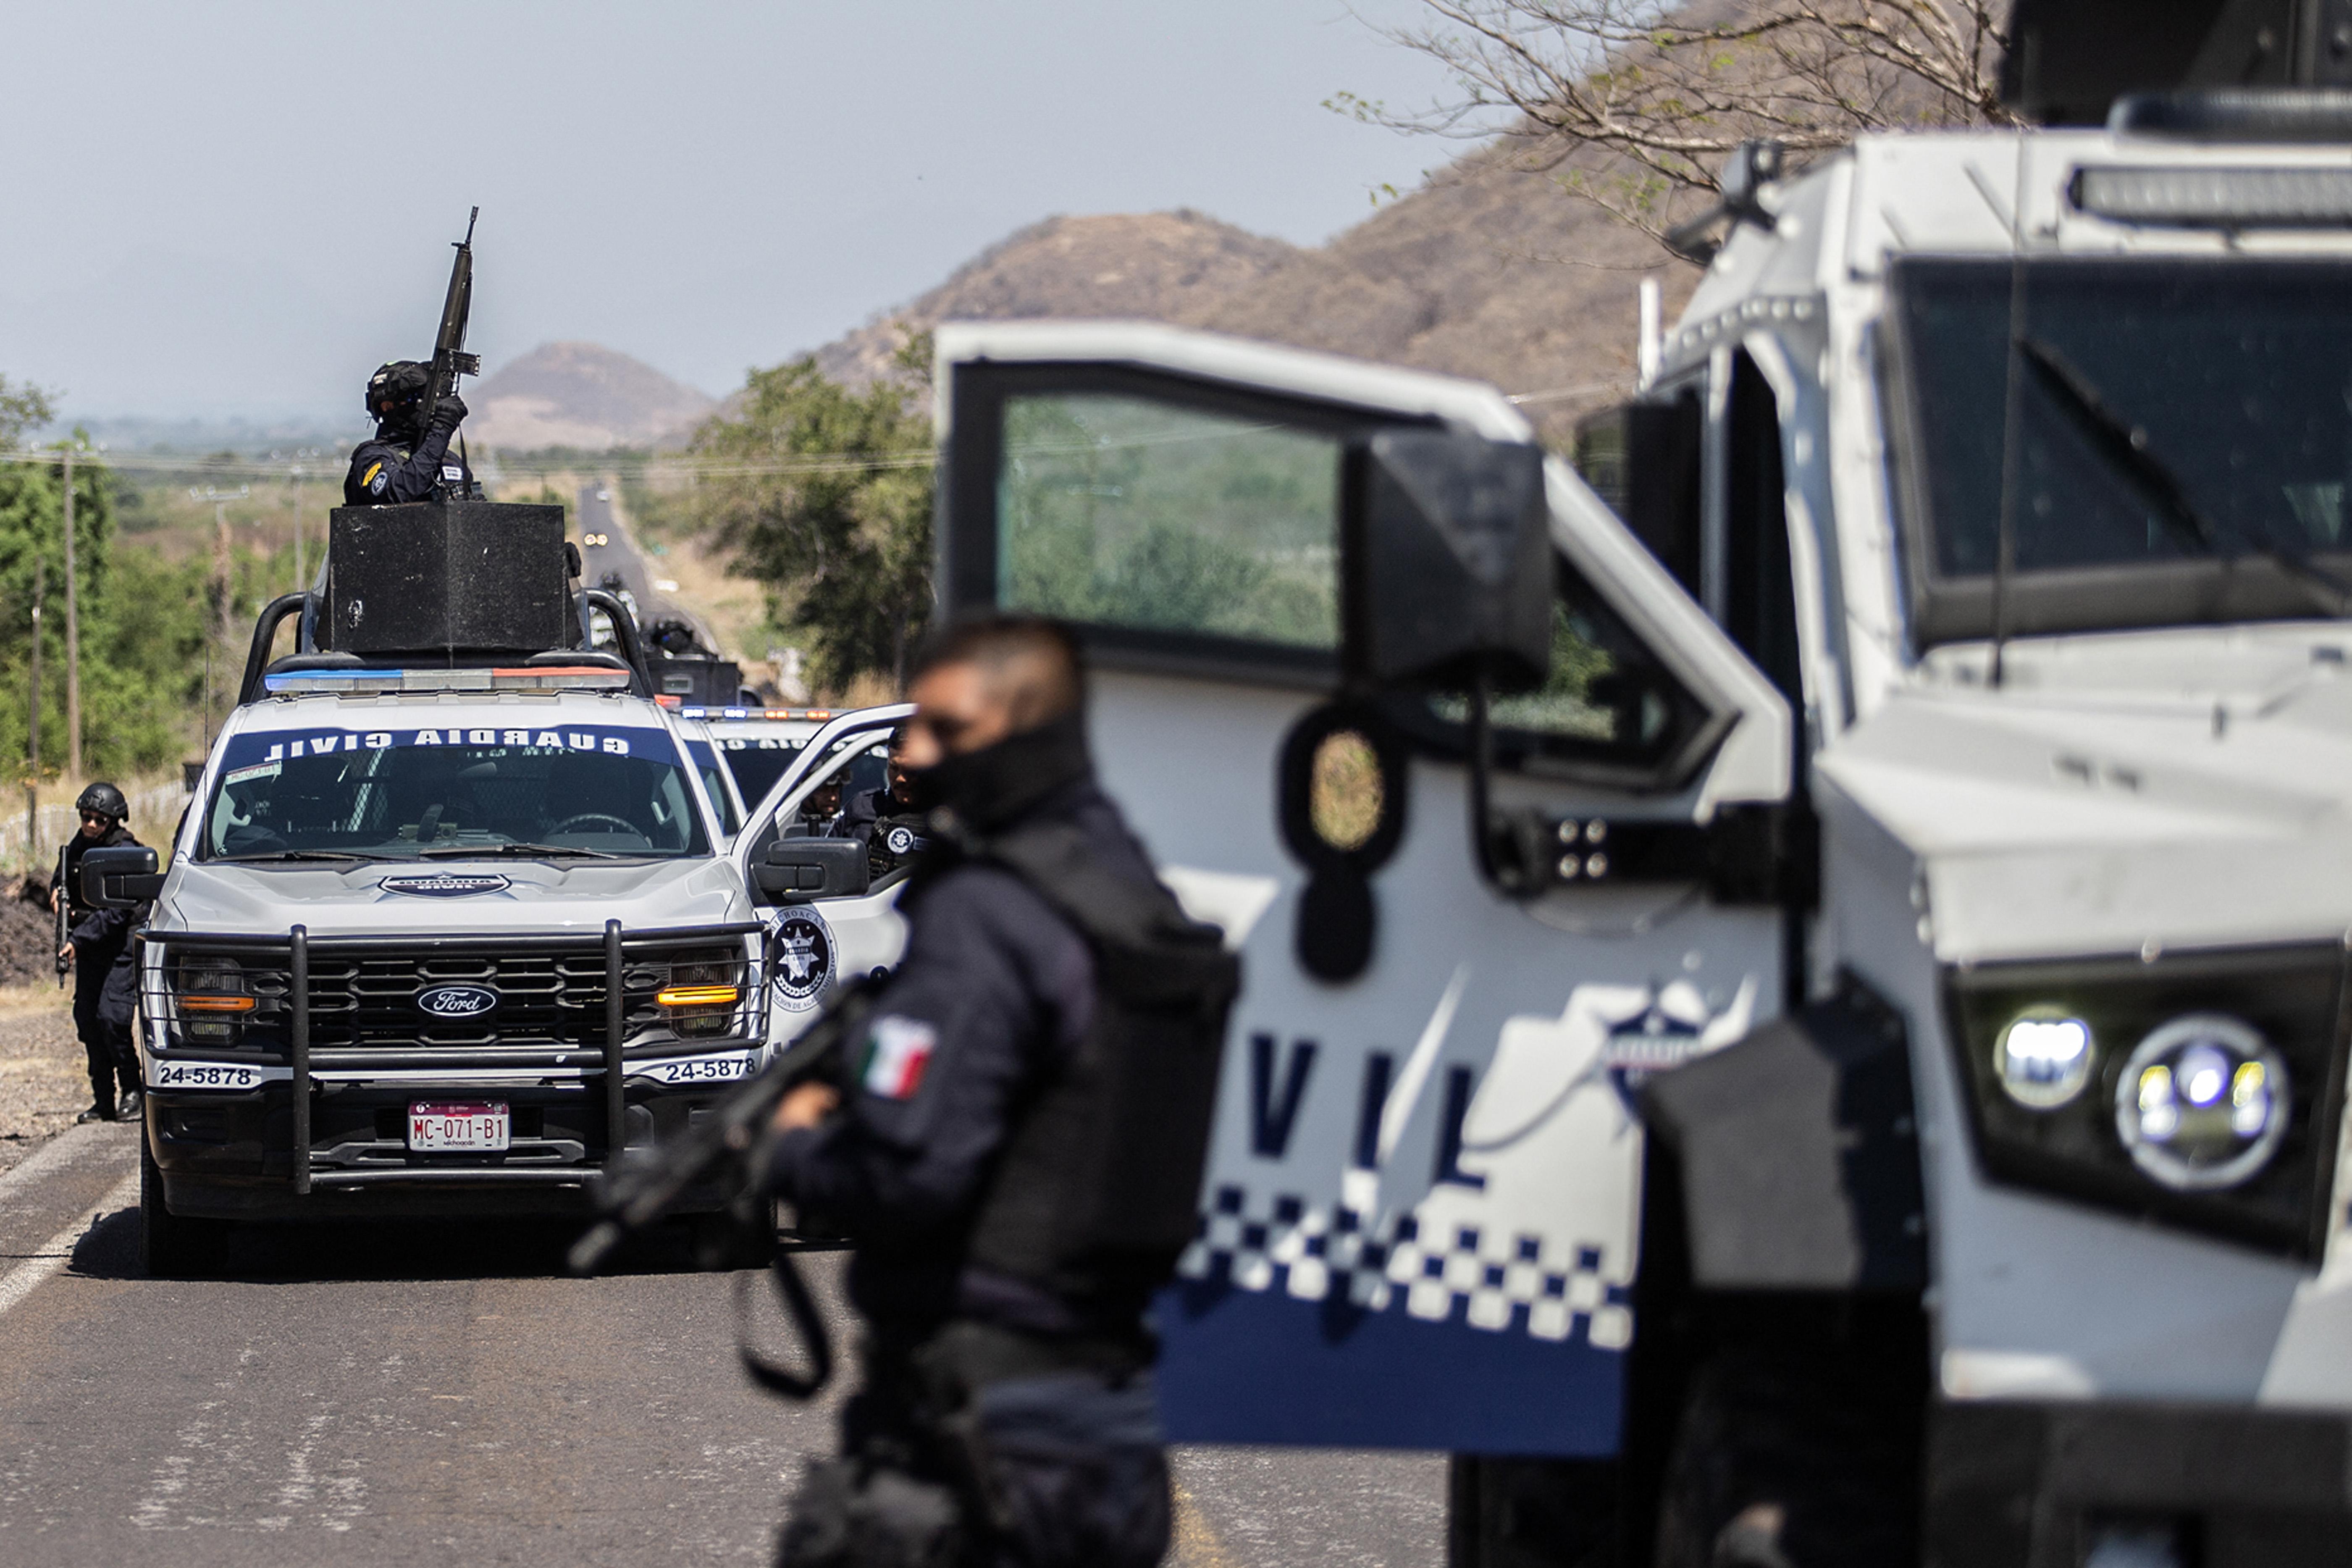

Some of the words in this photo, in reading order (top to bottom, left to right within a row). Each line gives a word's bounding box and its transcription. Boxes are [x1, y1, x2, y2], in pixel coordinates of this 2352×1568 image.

[433, 991, 481, 1011] Ford
[160, 1066, 252, 1085] 24-5878
[666, 1057, 756, 1081] 24-5878
[1248, 1029, 1487, 1191] VIL
[414, 1118, 503, 1140] MC-071-B1
